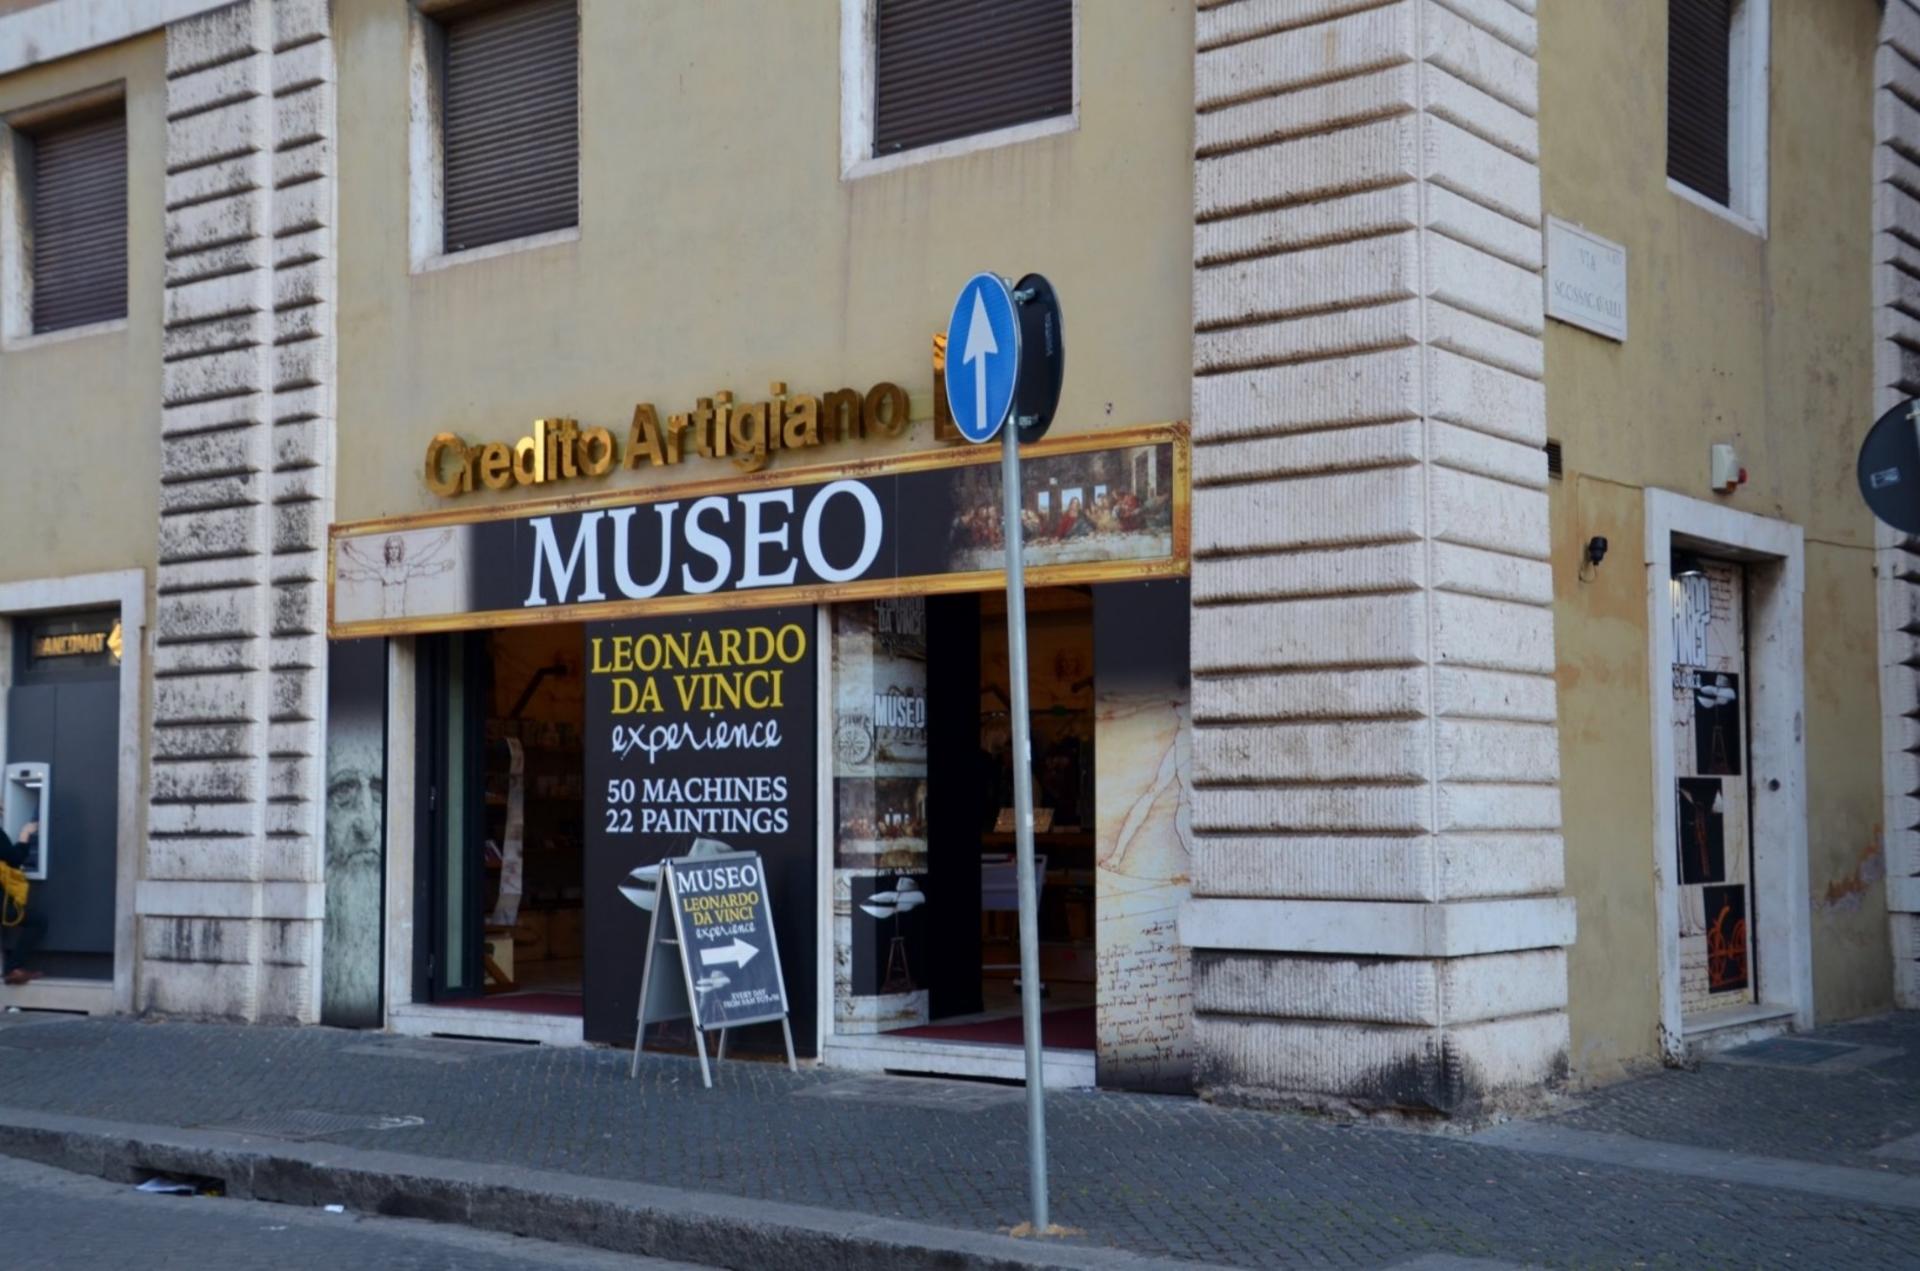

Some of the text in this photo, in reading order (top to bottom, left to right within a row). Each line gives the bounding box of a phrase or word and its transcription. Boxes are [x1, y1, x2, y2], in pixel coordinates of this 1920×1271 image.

[425, 418, 617, 498] Credito
[622, 381, 911, 473] Artigiano
[524, 479, 883, 607] MUSEO
[591, 624, 807, 674] LEONARDO
[611, 670, 784, 714] DA VINCI
[874, 694, 926, 729] MUSEO
[611, 712, 783, 764] experience
[607, 776, 788, 803] 50 MACHINES
[605, 808, 789, 833] 22 PAINTINGS
[676, 865, 758, 894] MUSEO
[683, 891, 759, 912] LEONARDO
[693, 906, 754, 926] DA VINCI
[696, 921, 756, 941] experience
